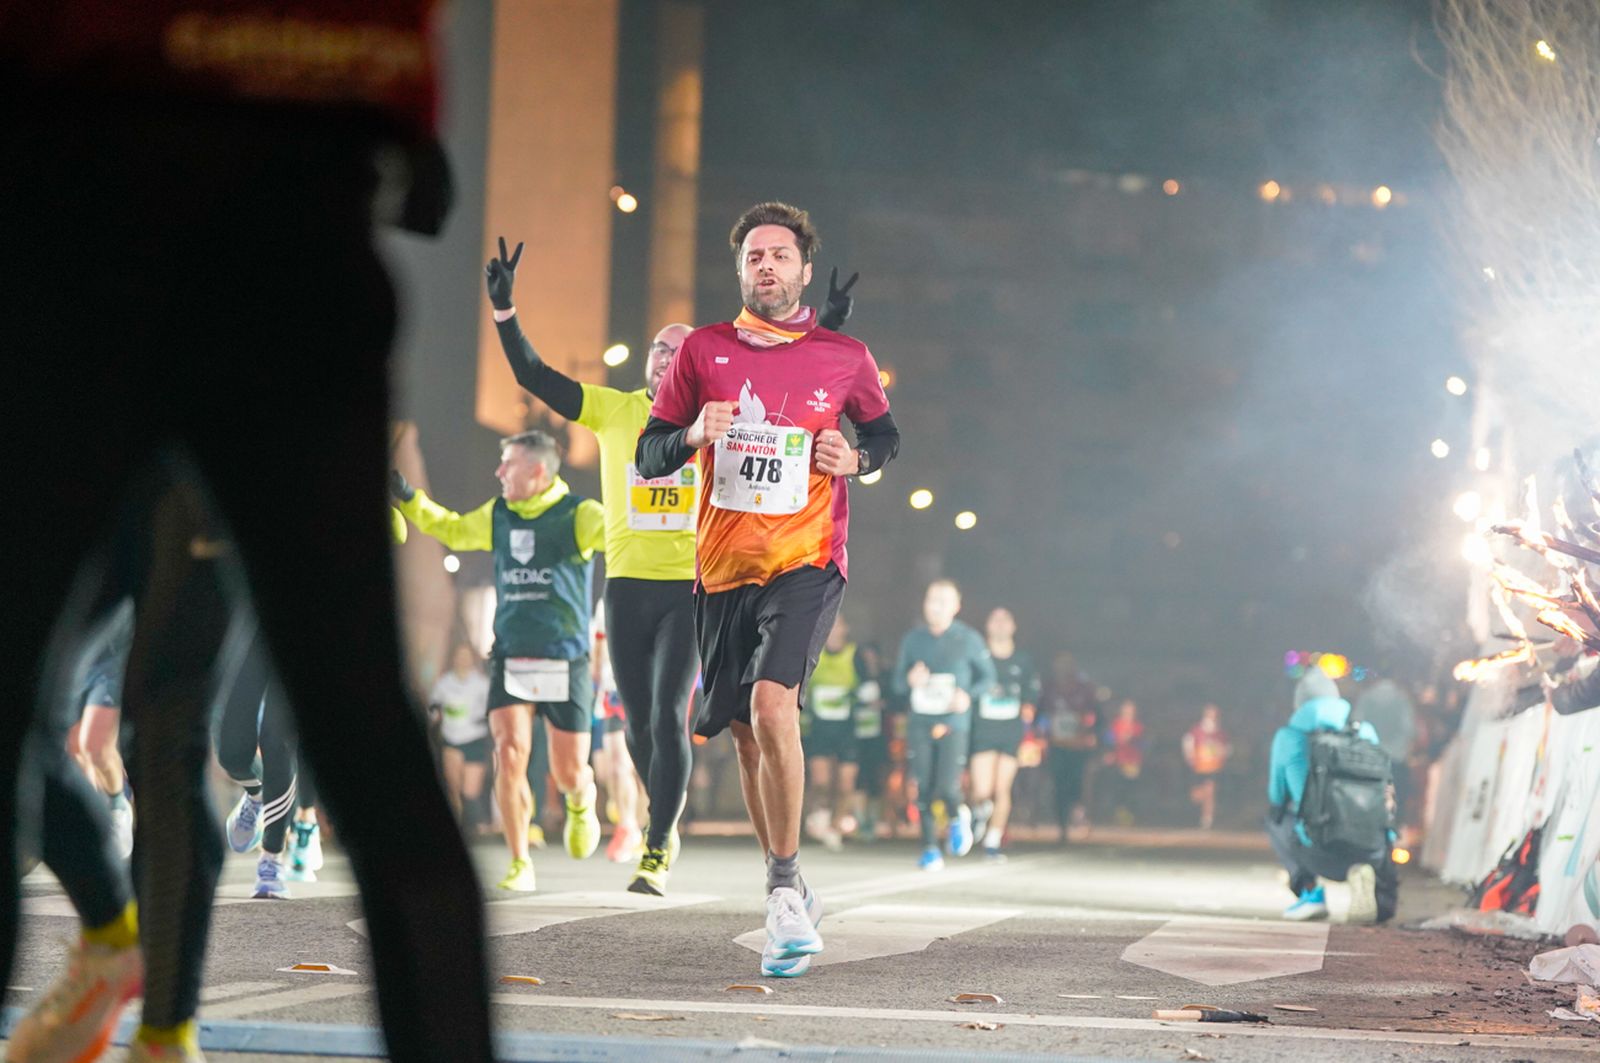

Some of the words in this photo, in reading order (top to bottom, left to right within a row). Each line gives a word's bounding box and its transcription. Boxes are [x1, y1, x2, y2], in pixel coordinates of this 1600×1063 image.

[726, 441, 744, 452] SAN
[736, 432, 763, 444] NOCHE
[766, 436, 778, 445] DE
[739, 455, 783, 484] 478
[648, 487, 680, 507] 775
